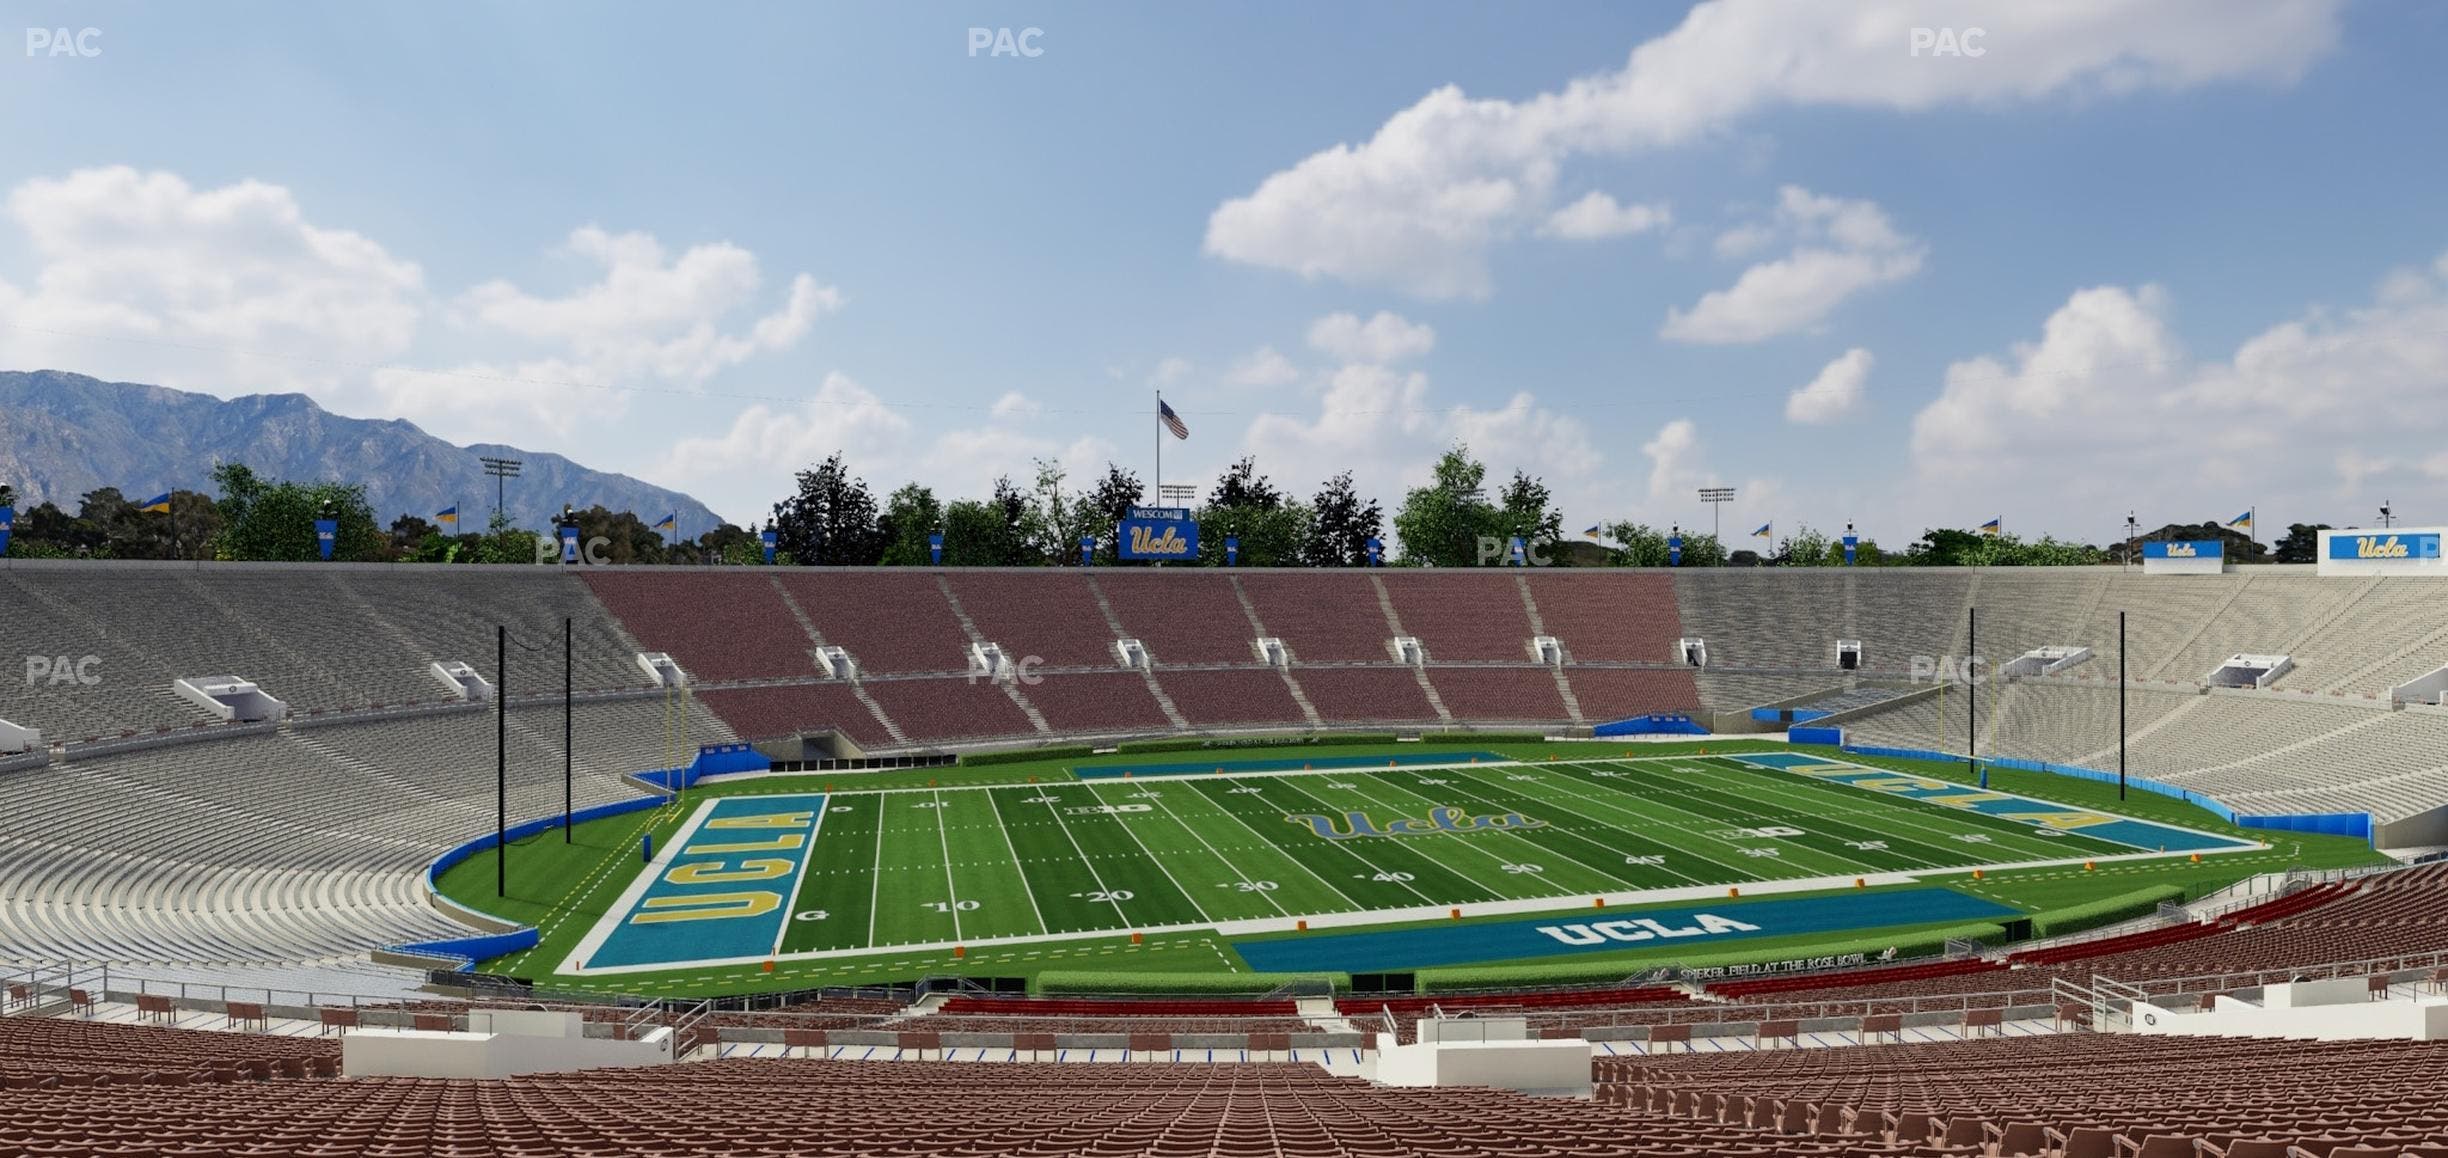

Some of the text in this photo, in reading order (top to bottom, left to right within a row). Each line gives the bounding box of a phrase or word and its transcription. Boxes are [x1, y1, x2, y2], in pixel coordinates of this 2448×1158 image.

[1130, 526, 1188, 554] Ucla
[2357, 536, 2409, 558] Ucla
[1284, 806, 1549, 839] Ucla
[629, 811, 815, 924] UCLA
[1501, 863, 1543, 874] 50
[1373, 872, 1415, 882] 40
[1234, 880, 1279, 892] 30
[1086, 890, 1134, 902] 20
[934, 900, 981, 912] 10
[795, 910, 830, 921] G
[1536, 914, 1762, 945] UCLA
[1728, 963, 1760, 976] FIELD
[1763, 961, 1779, 973] AT
[1781, 959, 1805, 971] THE
[1806, 956, 1834, 970] ROSE
[1837, 953, 1867, 967] BOWL
